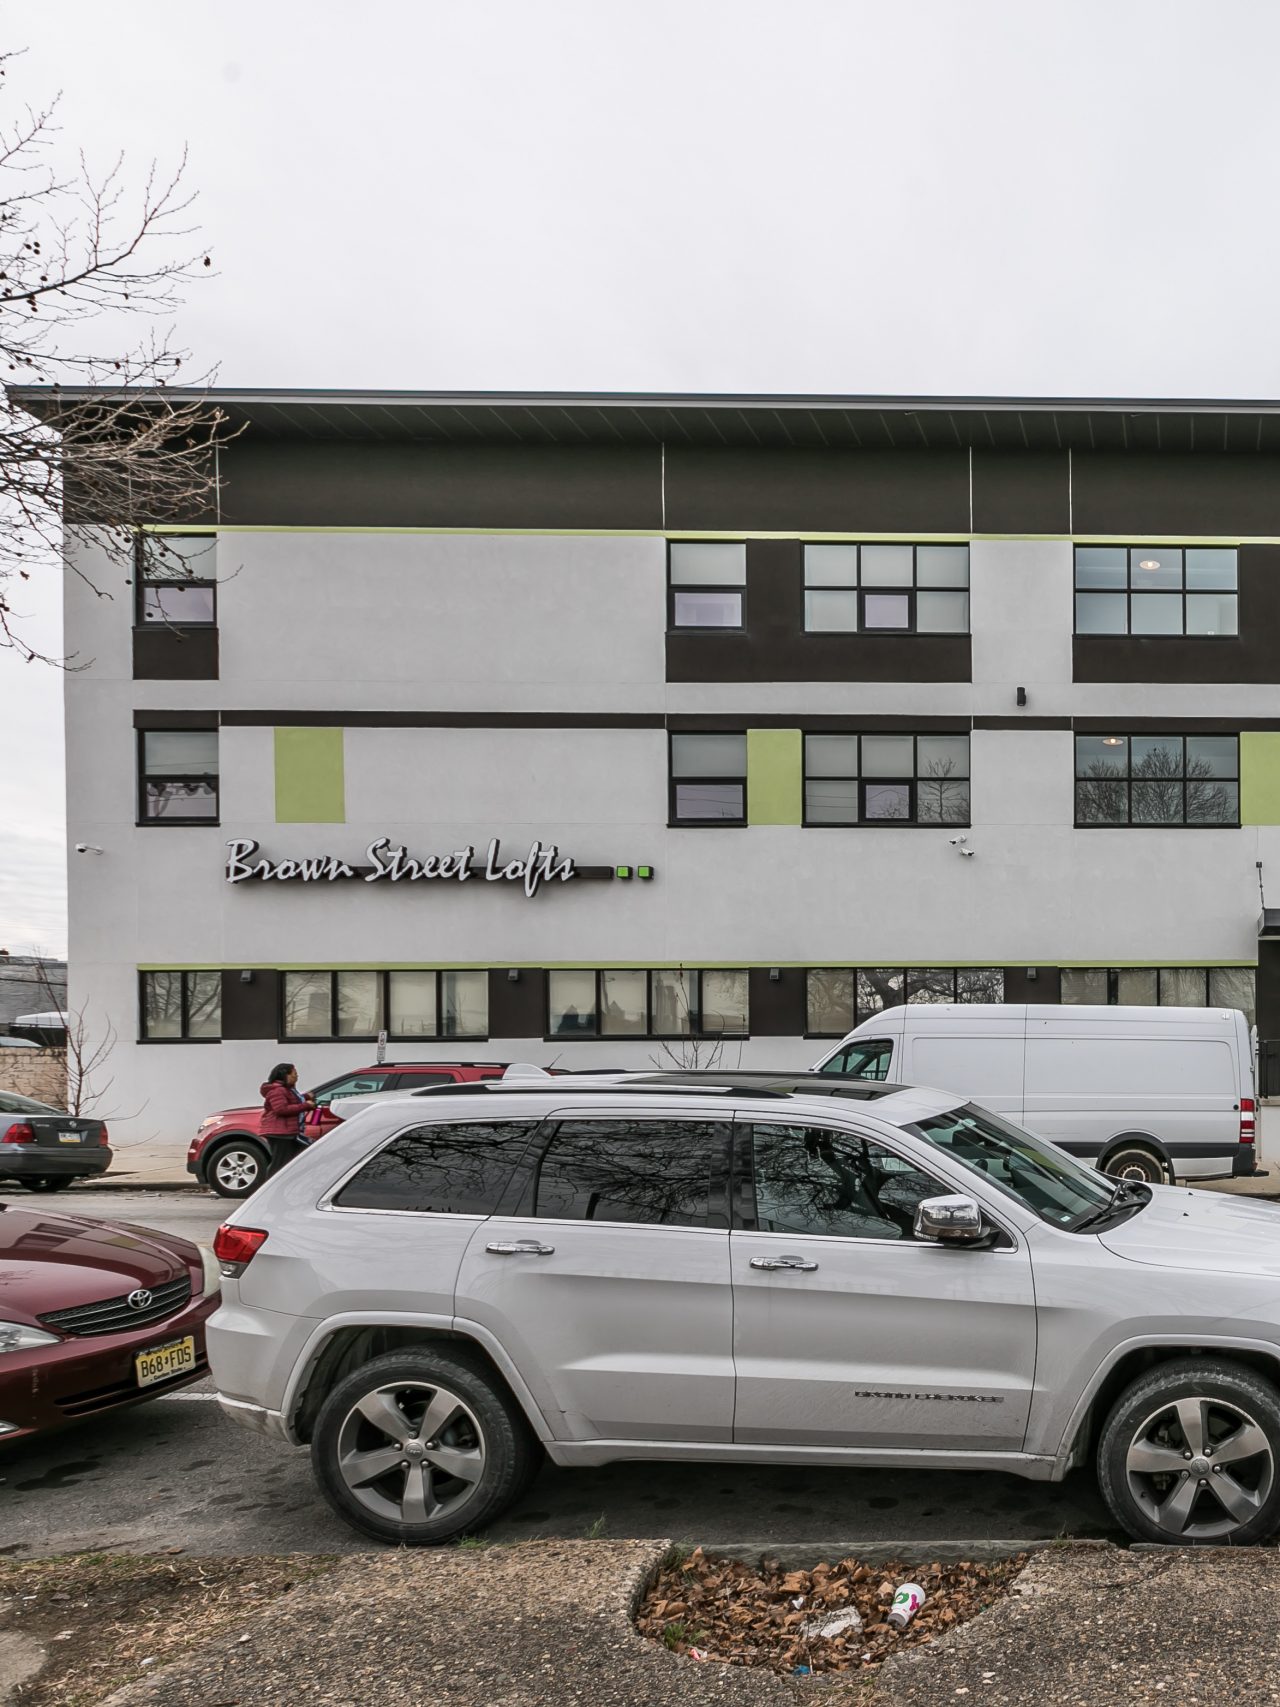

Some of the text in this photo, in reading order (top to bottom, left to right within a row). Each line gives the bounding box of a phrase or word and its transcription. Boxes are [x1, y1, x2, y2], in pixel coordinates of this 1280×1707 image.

[225, 837, 575, 898] Brown Street Lofts
[141, 1355, 164, 1379] B68
[169, 1345, 192, 1369] FDS
